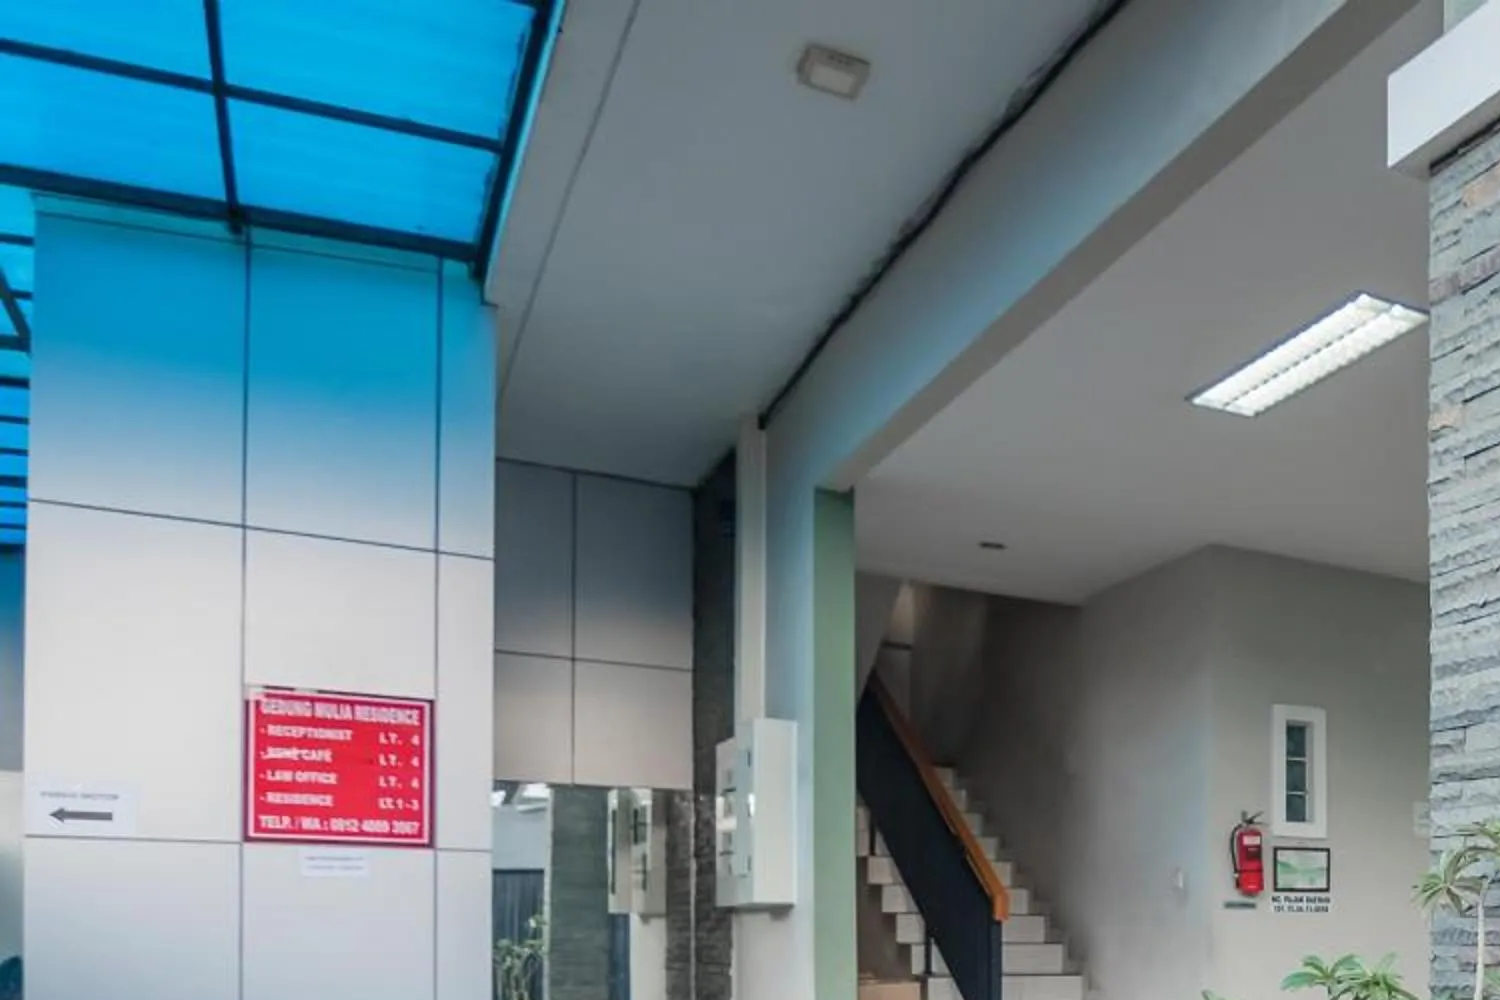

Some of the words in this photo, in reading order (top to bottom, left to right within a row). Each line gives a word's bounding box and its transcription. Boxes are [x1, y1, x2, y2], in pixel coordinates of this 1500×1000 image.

[354, 705, 420, 725] RESIDENCE
[267, 724, 352, 740] RECEPTIONIST
[411, 733, 420, 745] 4
[411, 755, 420, 767] 4
[295, 771, 337, 784] OFFICE
[411, 777, 420, 789] 4
[266, 792, 334, 806] RESIDENCE
